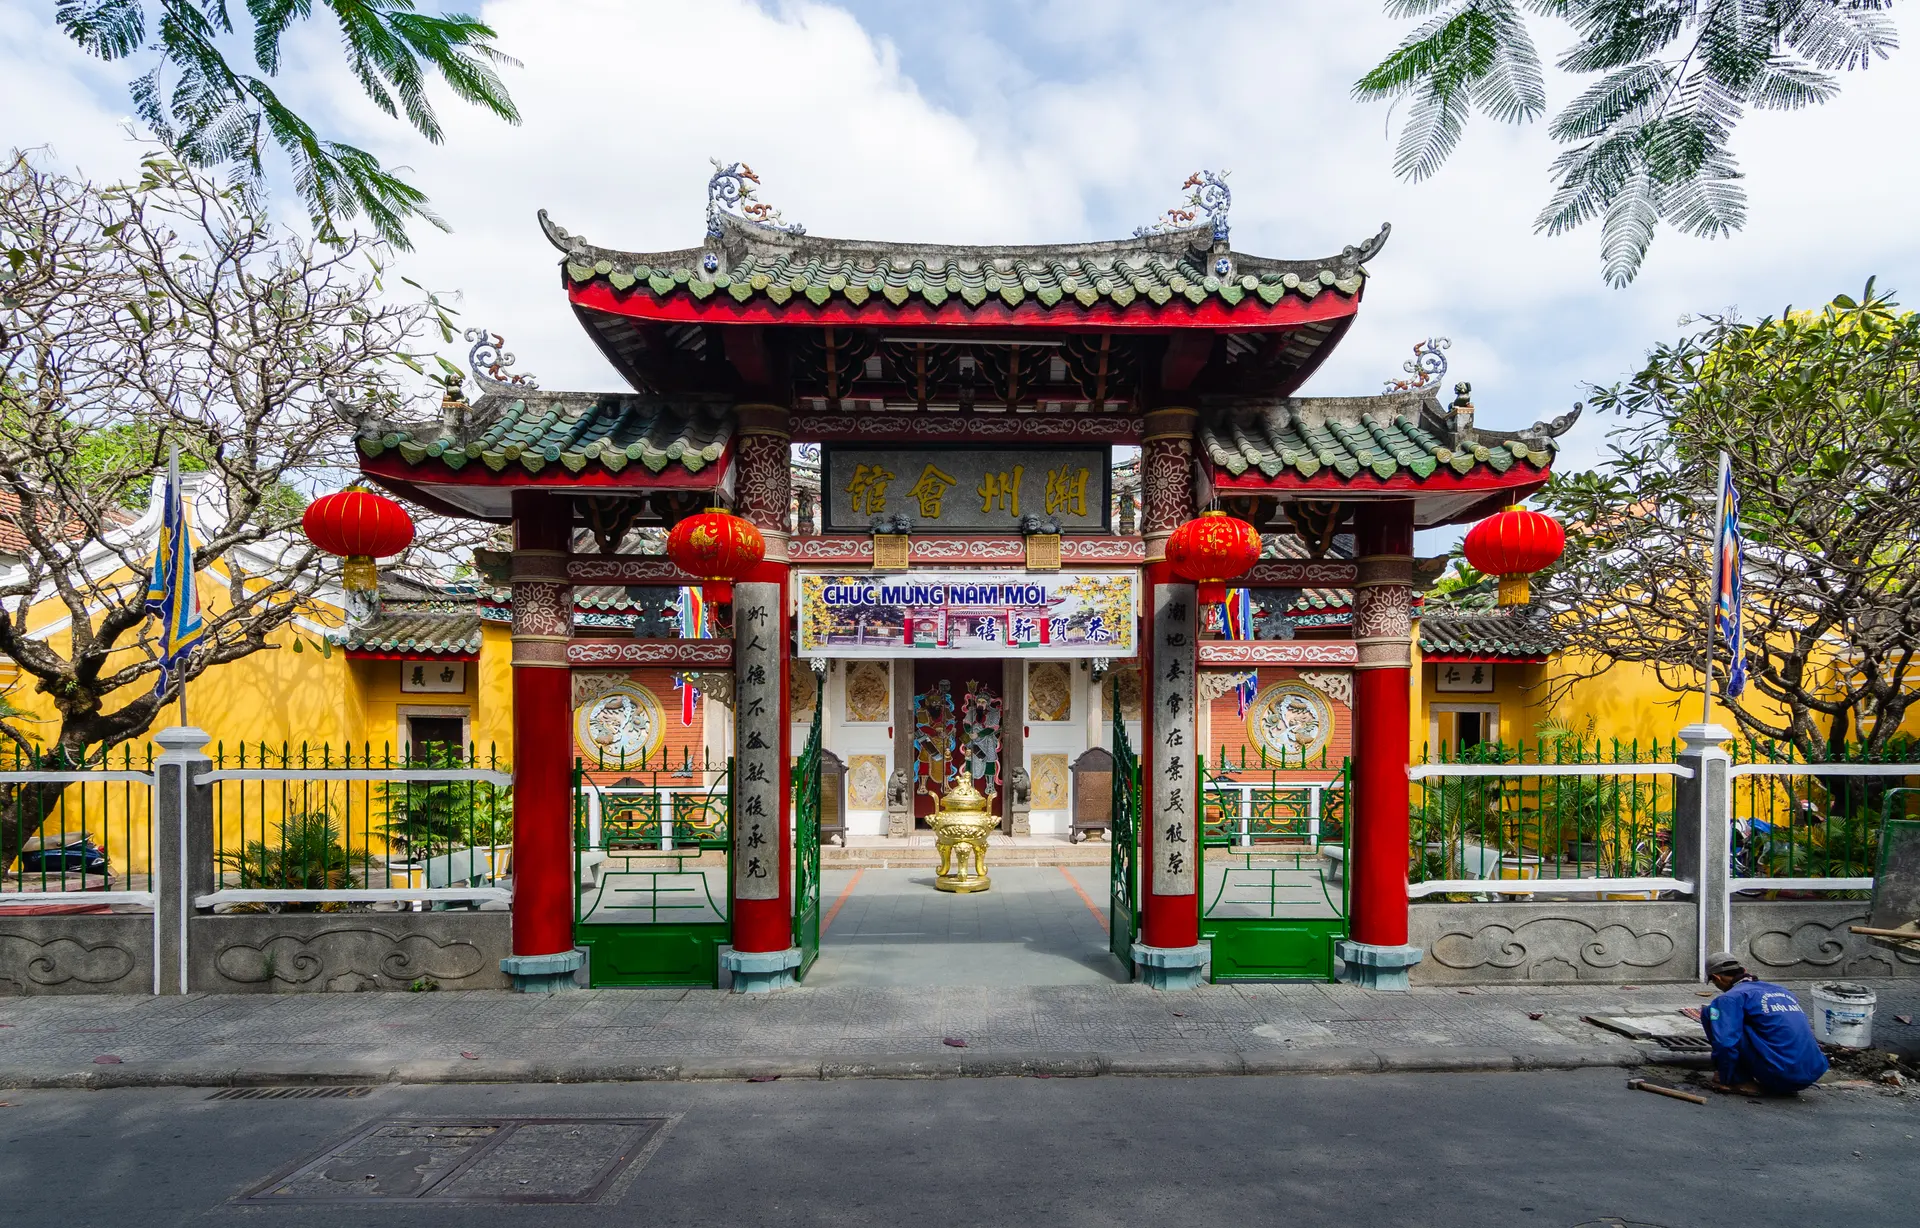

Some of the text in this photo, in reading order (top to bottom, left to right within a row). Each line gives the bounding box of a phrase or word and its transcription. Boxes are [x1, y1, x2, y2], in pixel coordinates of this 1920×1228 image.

[823, 580, 1046, 606] CHÚC MỪNG NĂM MỚI
